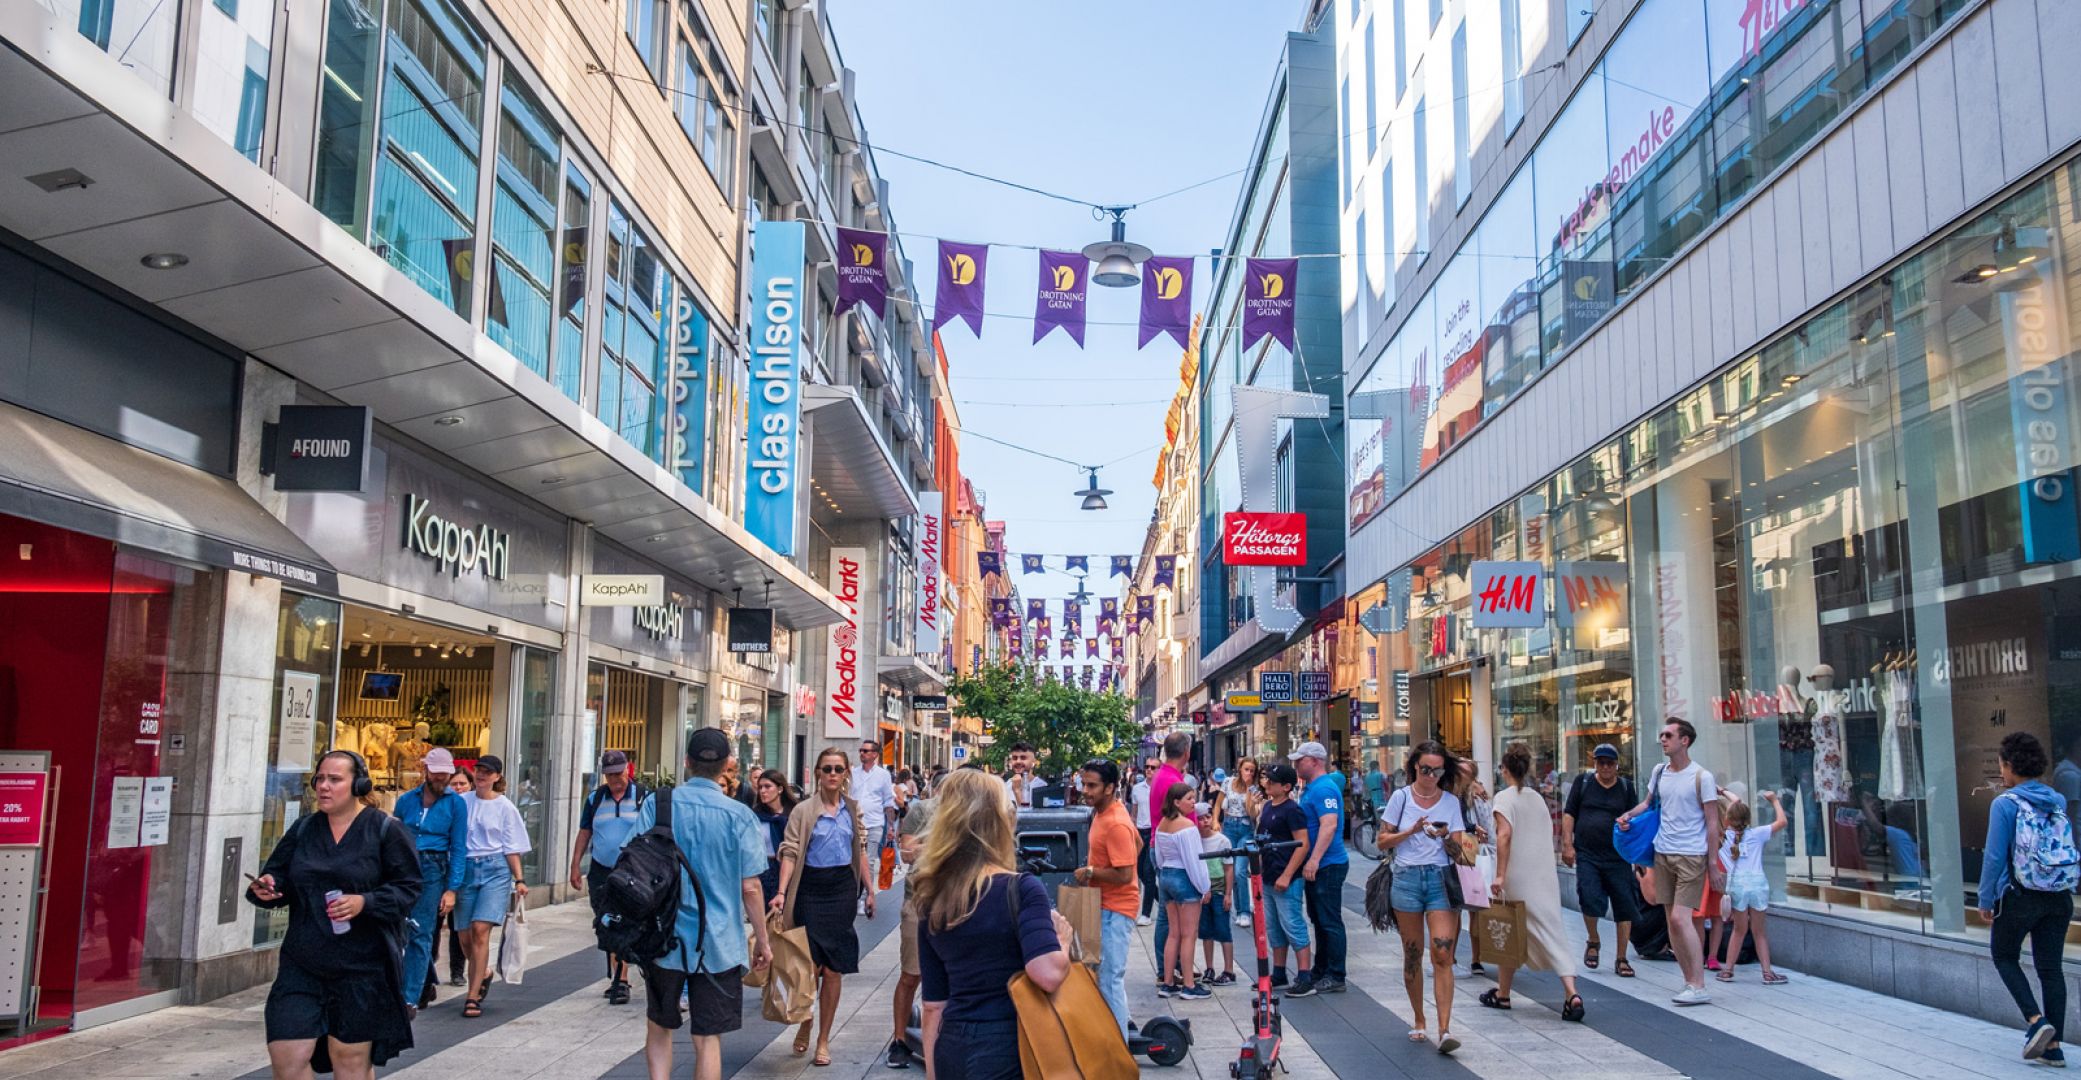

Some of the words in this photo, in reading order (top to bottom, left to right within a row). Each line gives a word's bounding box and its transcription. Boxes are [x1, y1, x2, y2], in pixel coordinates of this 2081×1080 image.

[1602, 105, 1675, 195] remake
[848, 274, 873, 284] GATAN
[1039, 290, 1085, 302] DROTTNING
[1247, 299, 1292, 308] DROTTNING
[1047, 300, 1073, 309] GATAN
[1257, 308, 1281, 316] GATAN
[755, 277, 795, 405] ohlson
[292, 439, 350, 458] AFOUND
[752, 412, 790, 495] clas
[407, 493, 510, 581] KappAhl
[920, 513, 939, 564] Markt
[1231, 519, 1302, 546] Hötorgs
[1233, 545, 1298, 556] PASSAGEN
[251, 555, 271, 573] THINGS
[271, 560, 279, 575] TO
[279, 563, 287, 577] BE
[592, 582, 648, 597] KappAhl
[1479, 574, 1537, 614] H&M
[920, 576, 938, 631] Media
[732, 642, 768, 652] BROTHERS
[1264, 675, 1289, 683] HALL
[1264, 682, 1290, 690] BERG
[831, 649, 858, 729] Media
[1264, 691, 1290, 700] GULD
[287, 686, 295, 717] 3
[305, 688, 313, 718] 2
[913, 700, 946, 709] stadium
[139, 718, 159, 735] CARD
[4, 803, 22, 813] 20%
